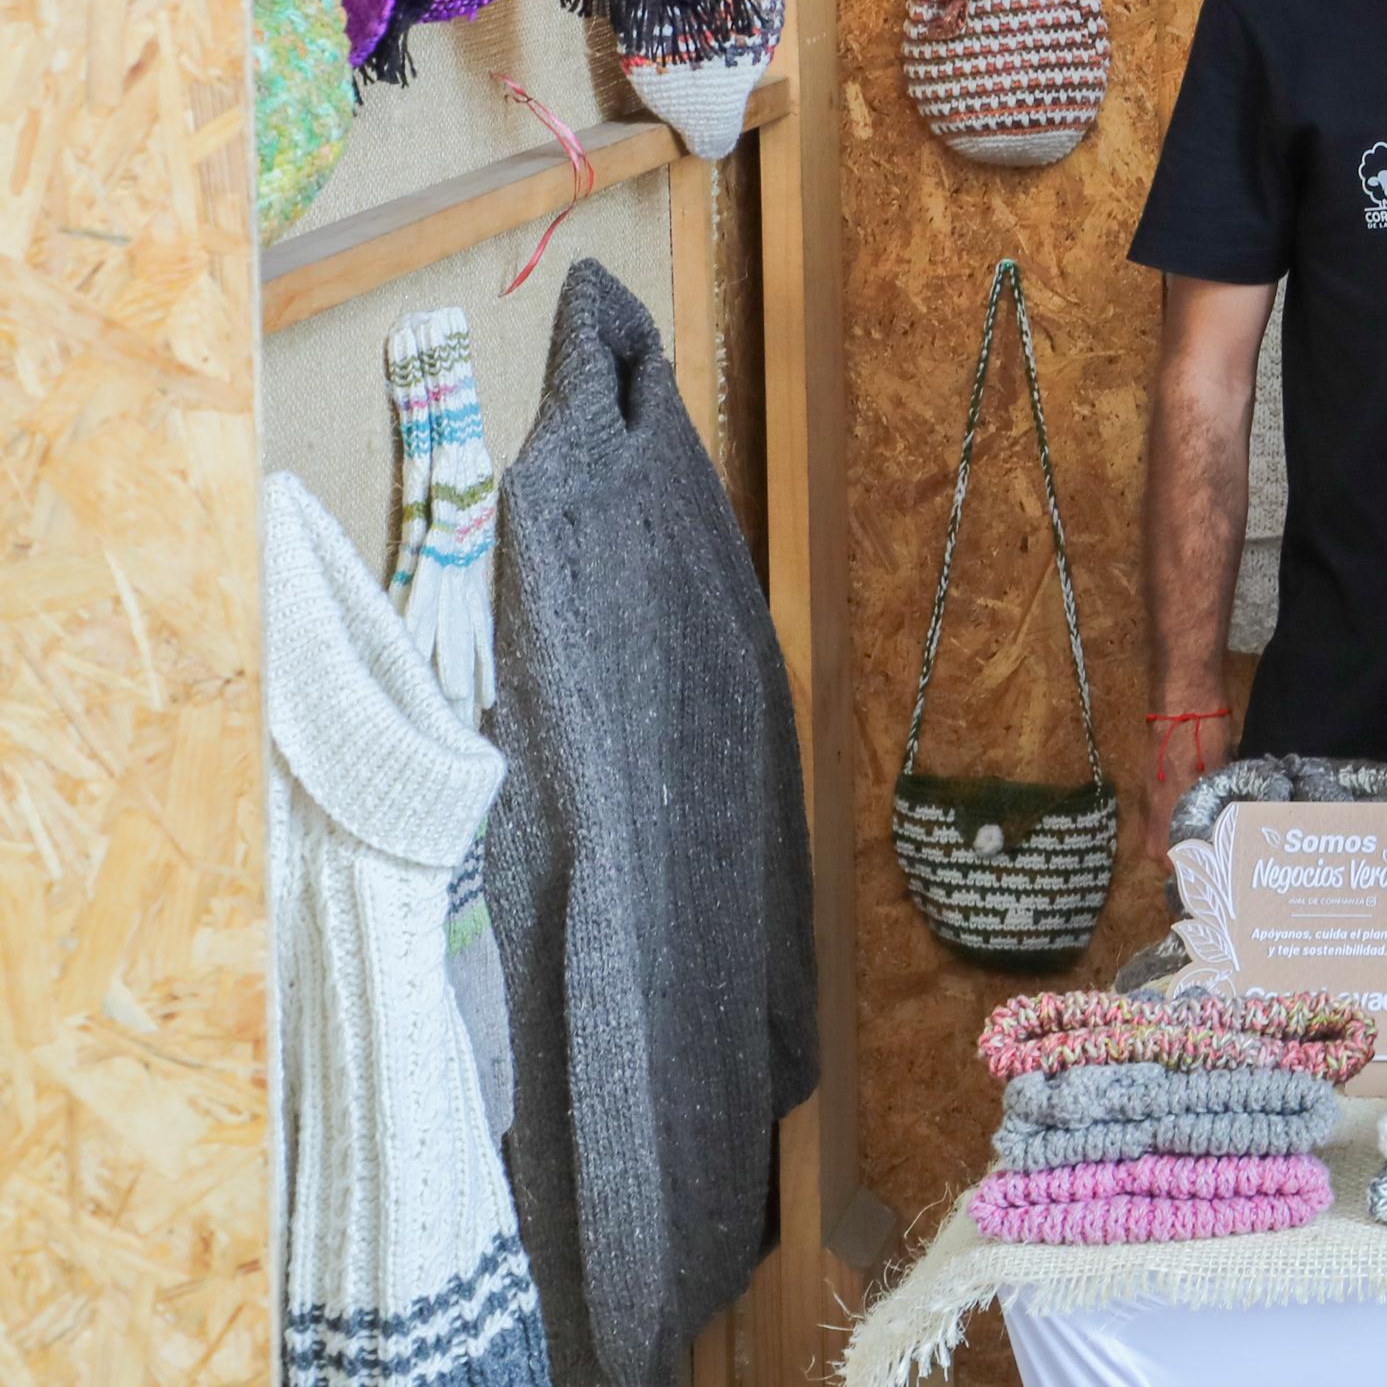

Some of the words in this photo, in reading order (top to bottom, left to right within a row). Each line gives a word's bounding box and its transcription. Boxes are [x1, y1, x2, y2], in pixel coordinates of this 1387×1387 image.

[1284, 828, 1377, 854] Somos
[1252, 857, 1345, 895] Negocios
[1315, 928, 1347, 940] cuida
[1350, 928, 1361, 940] el
[1267, 946, 1275, 958] y
[1278, 944, 1300, 958] teje
[1302, 944, 1387, 956] sostenibilidad.
